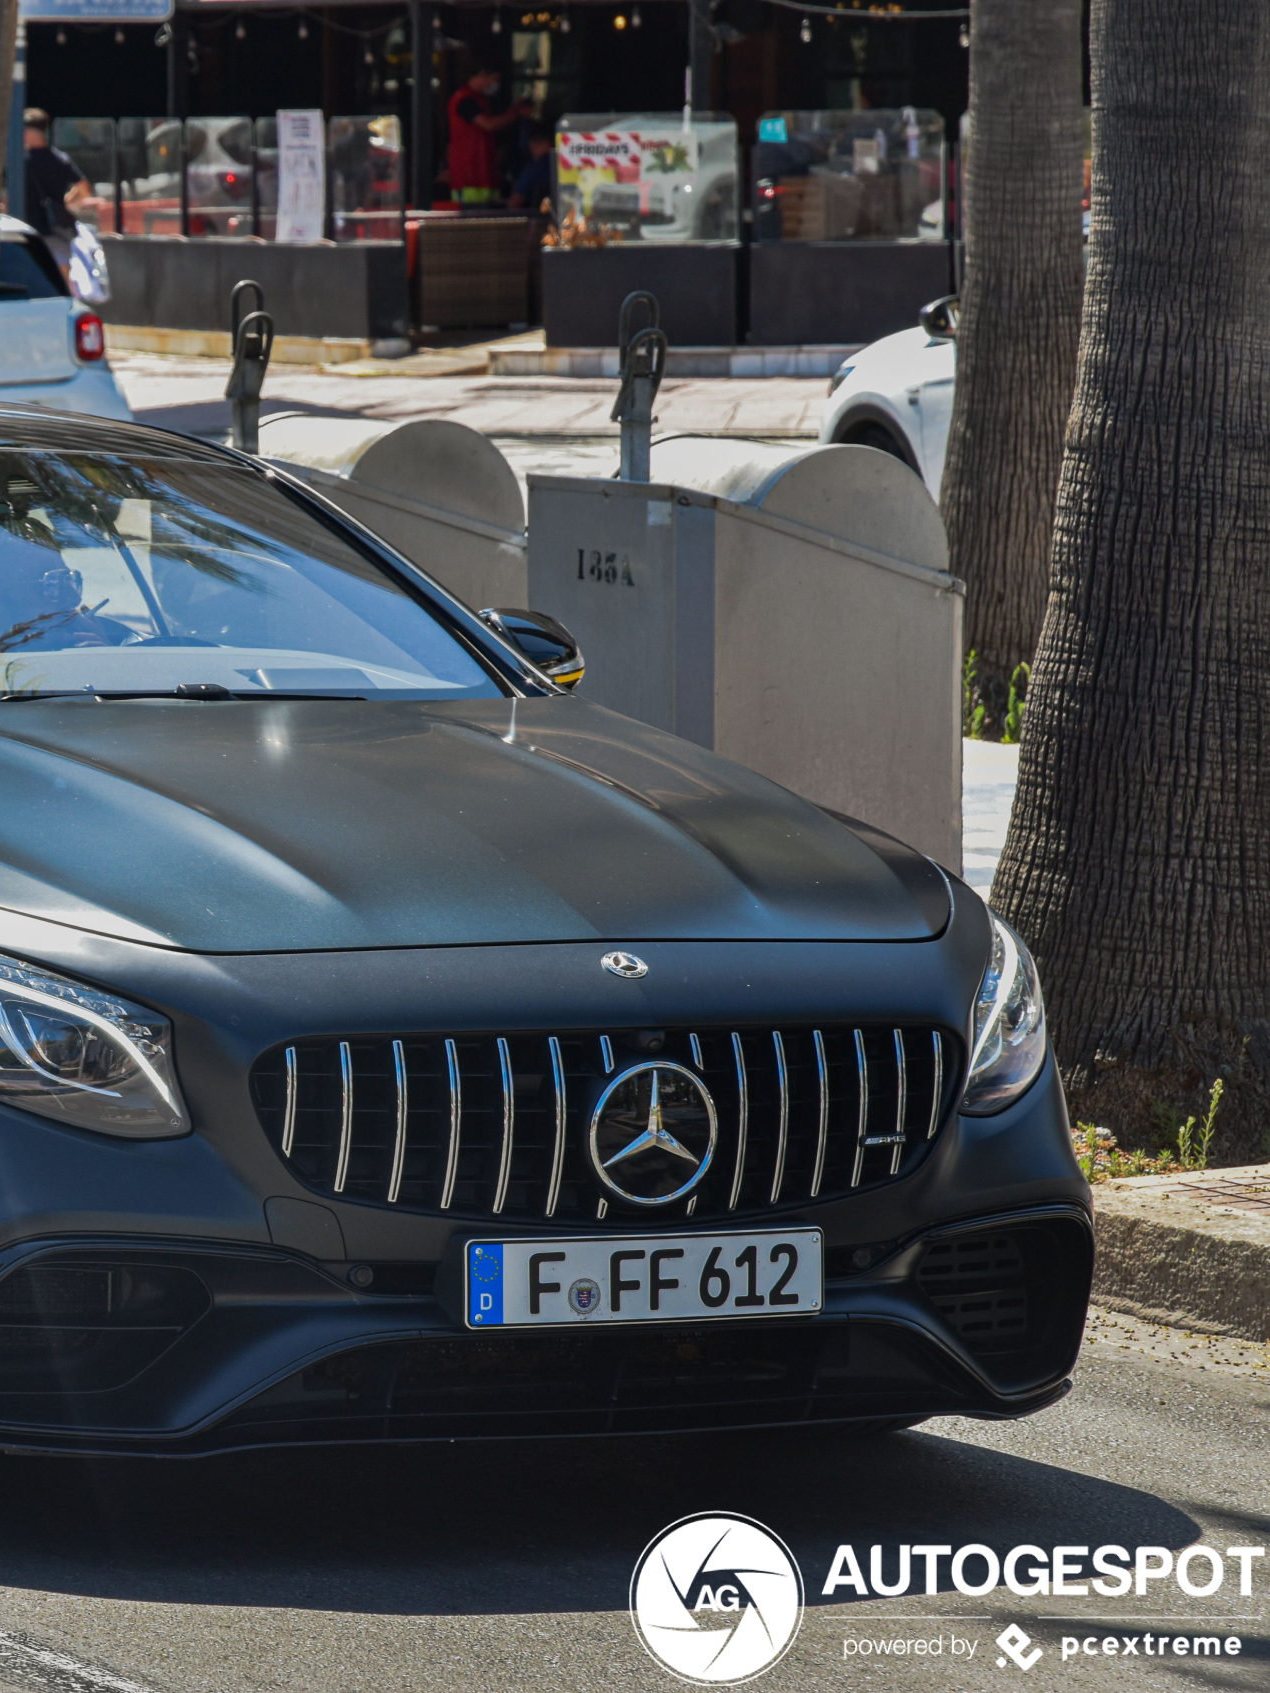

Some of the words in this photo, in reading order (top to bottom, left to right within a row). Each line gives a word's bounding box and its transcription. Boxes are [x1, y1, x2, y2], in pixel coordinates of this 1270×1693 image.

[528, 1251, 566, 1315] F
[609, 1248, 685, 1312] FF
[698, 1242, 799, 1308] 612
[479, 1292, 493, 1312] D
